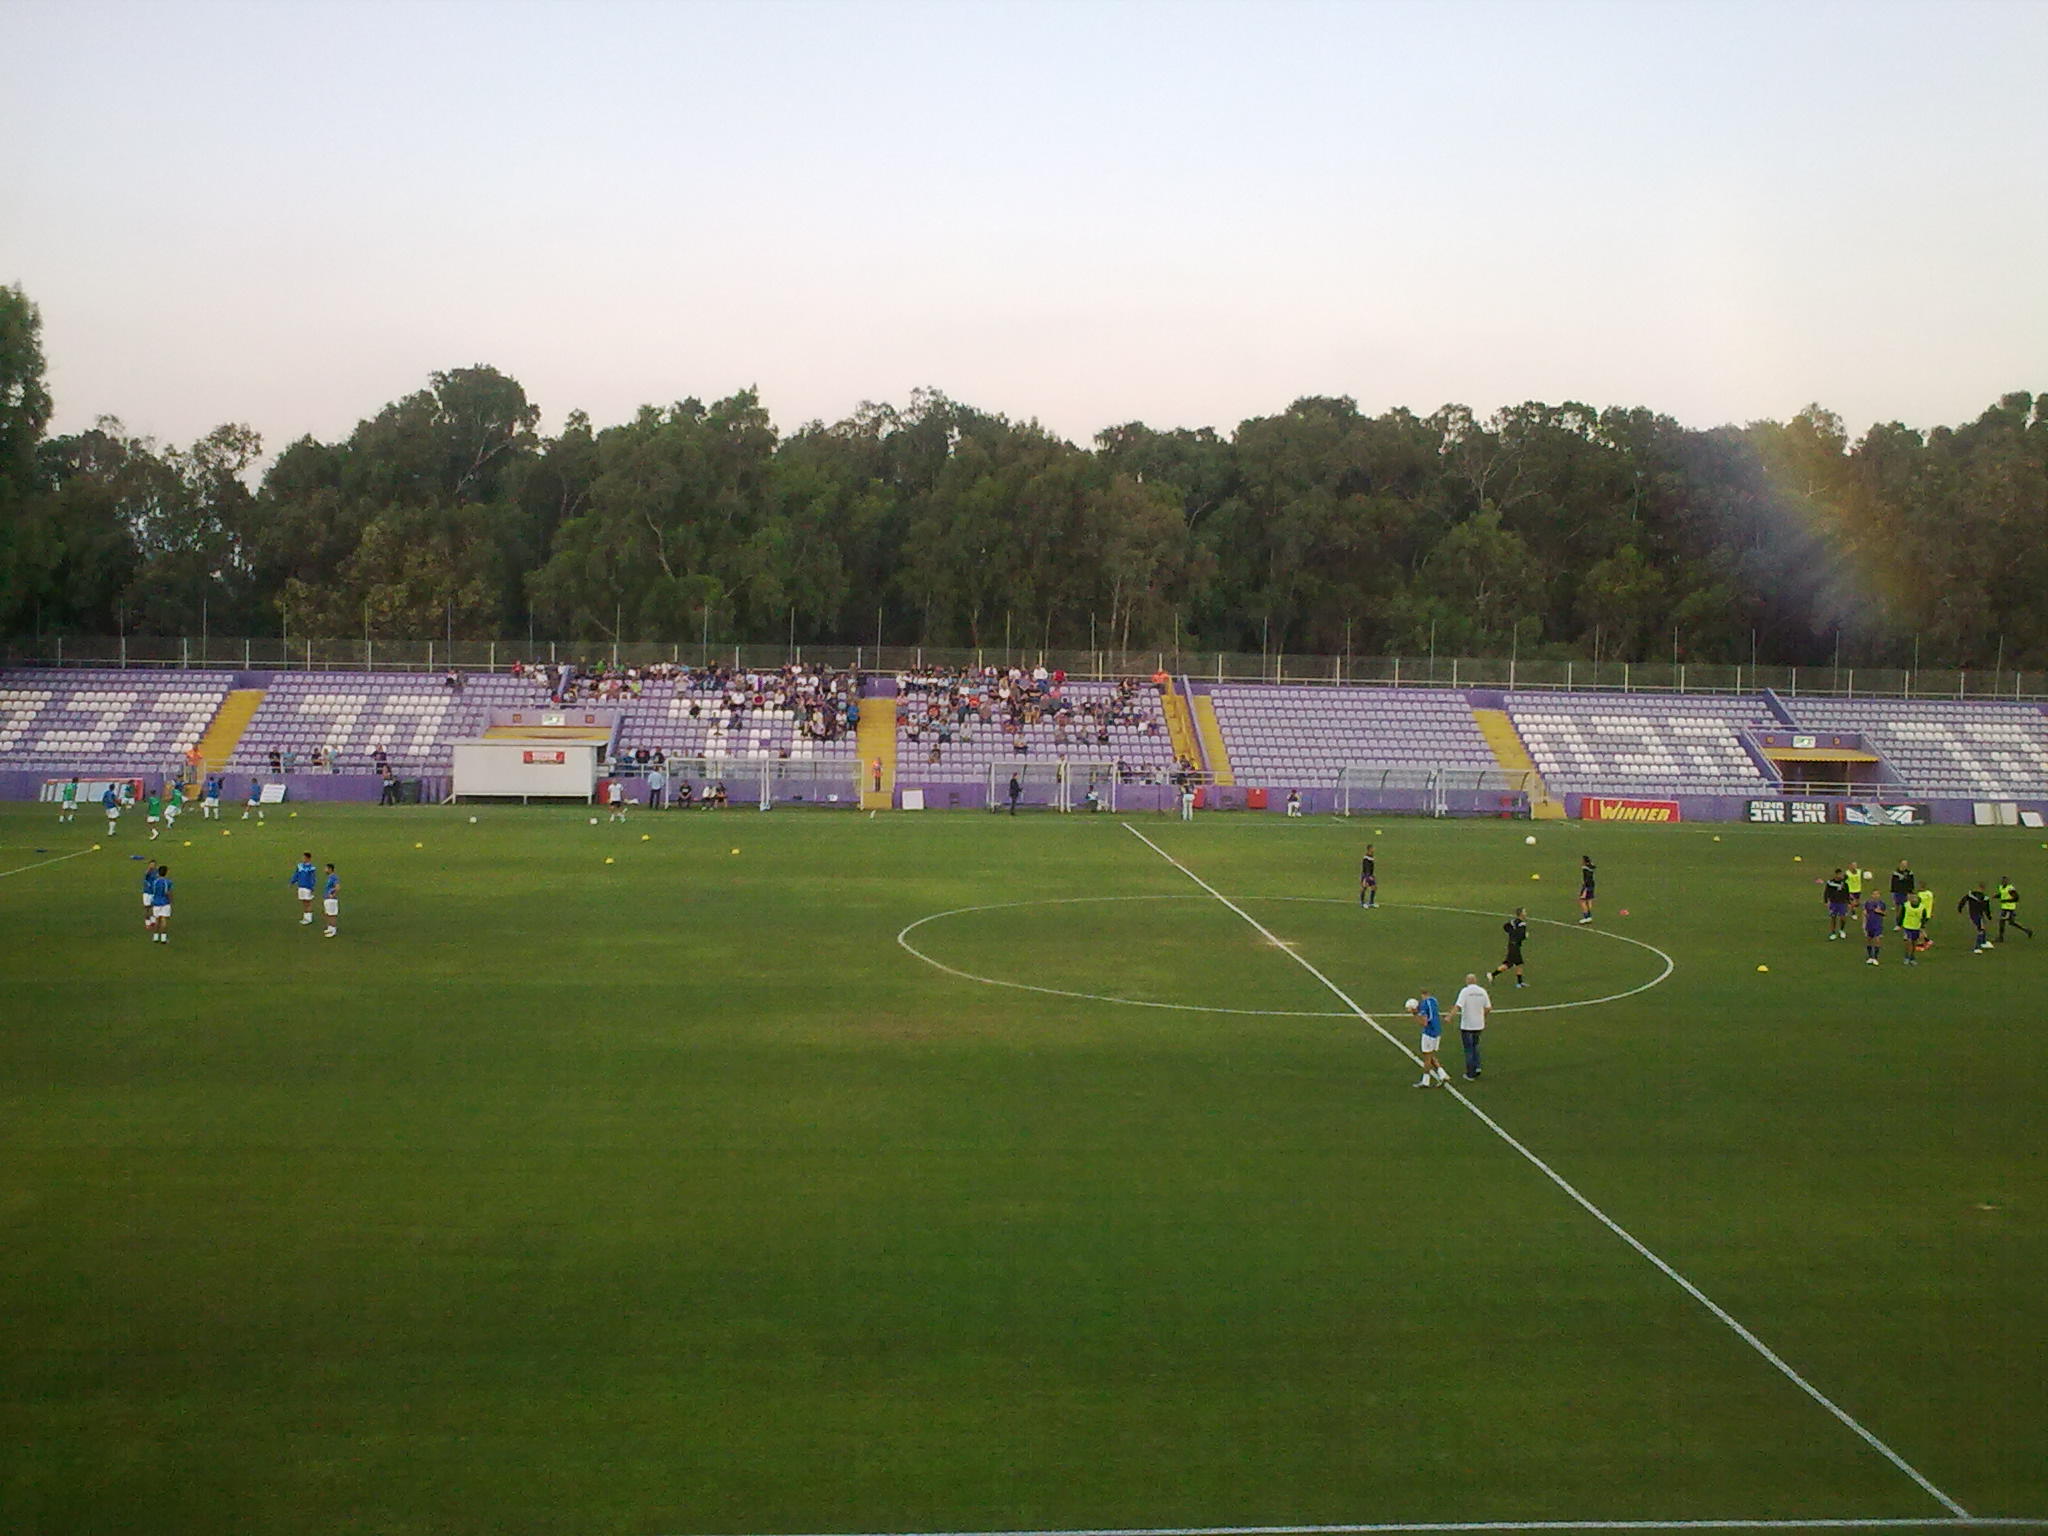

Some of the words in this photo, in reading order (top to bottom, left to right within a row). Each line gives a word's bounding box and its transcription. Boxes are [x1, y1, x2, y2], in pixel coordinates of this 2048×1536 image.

[1600, 800, 1671, 822] WINNER
[1751, 810, 1785, 822] זהב
[1792, 811, 1827, 824] זהב
